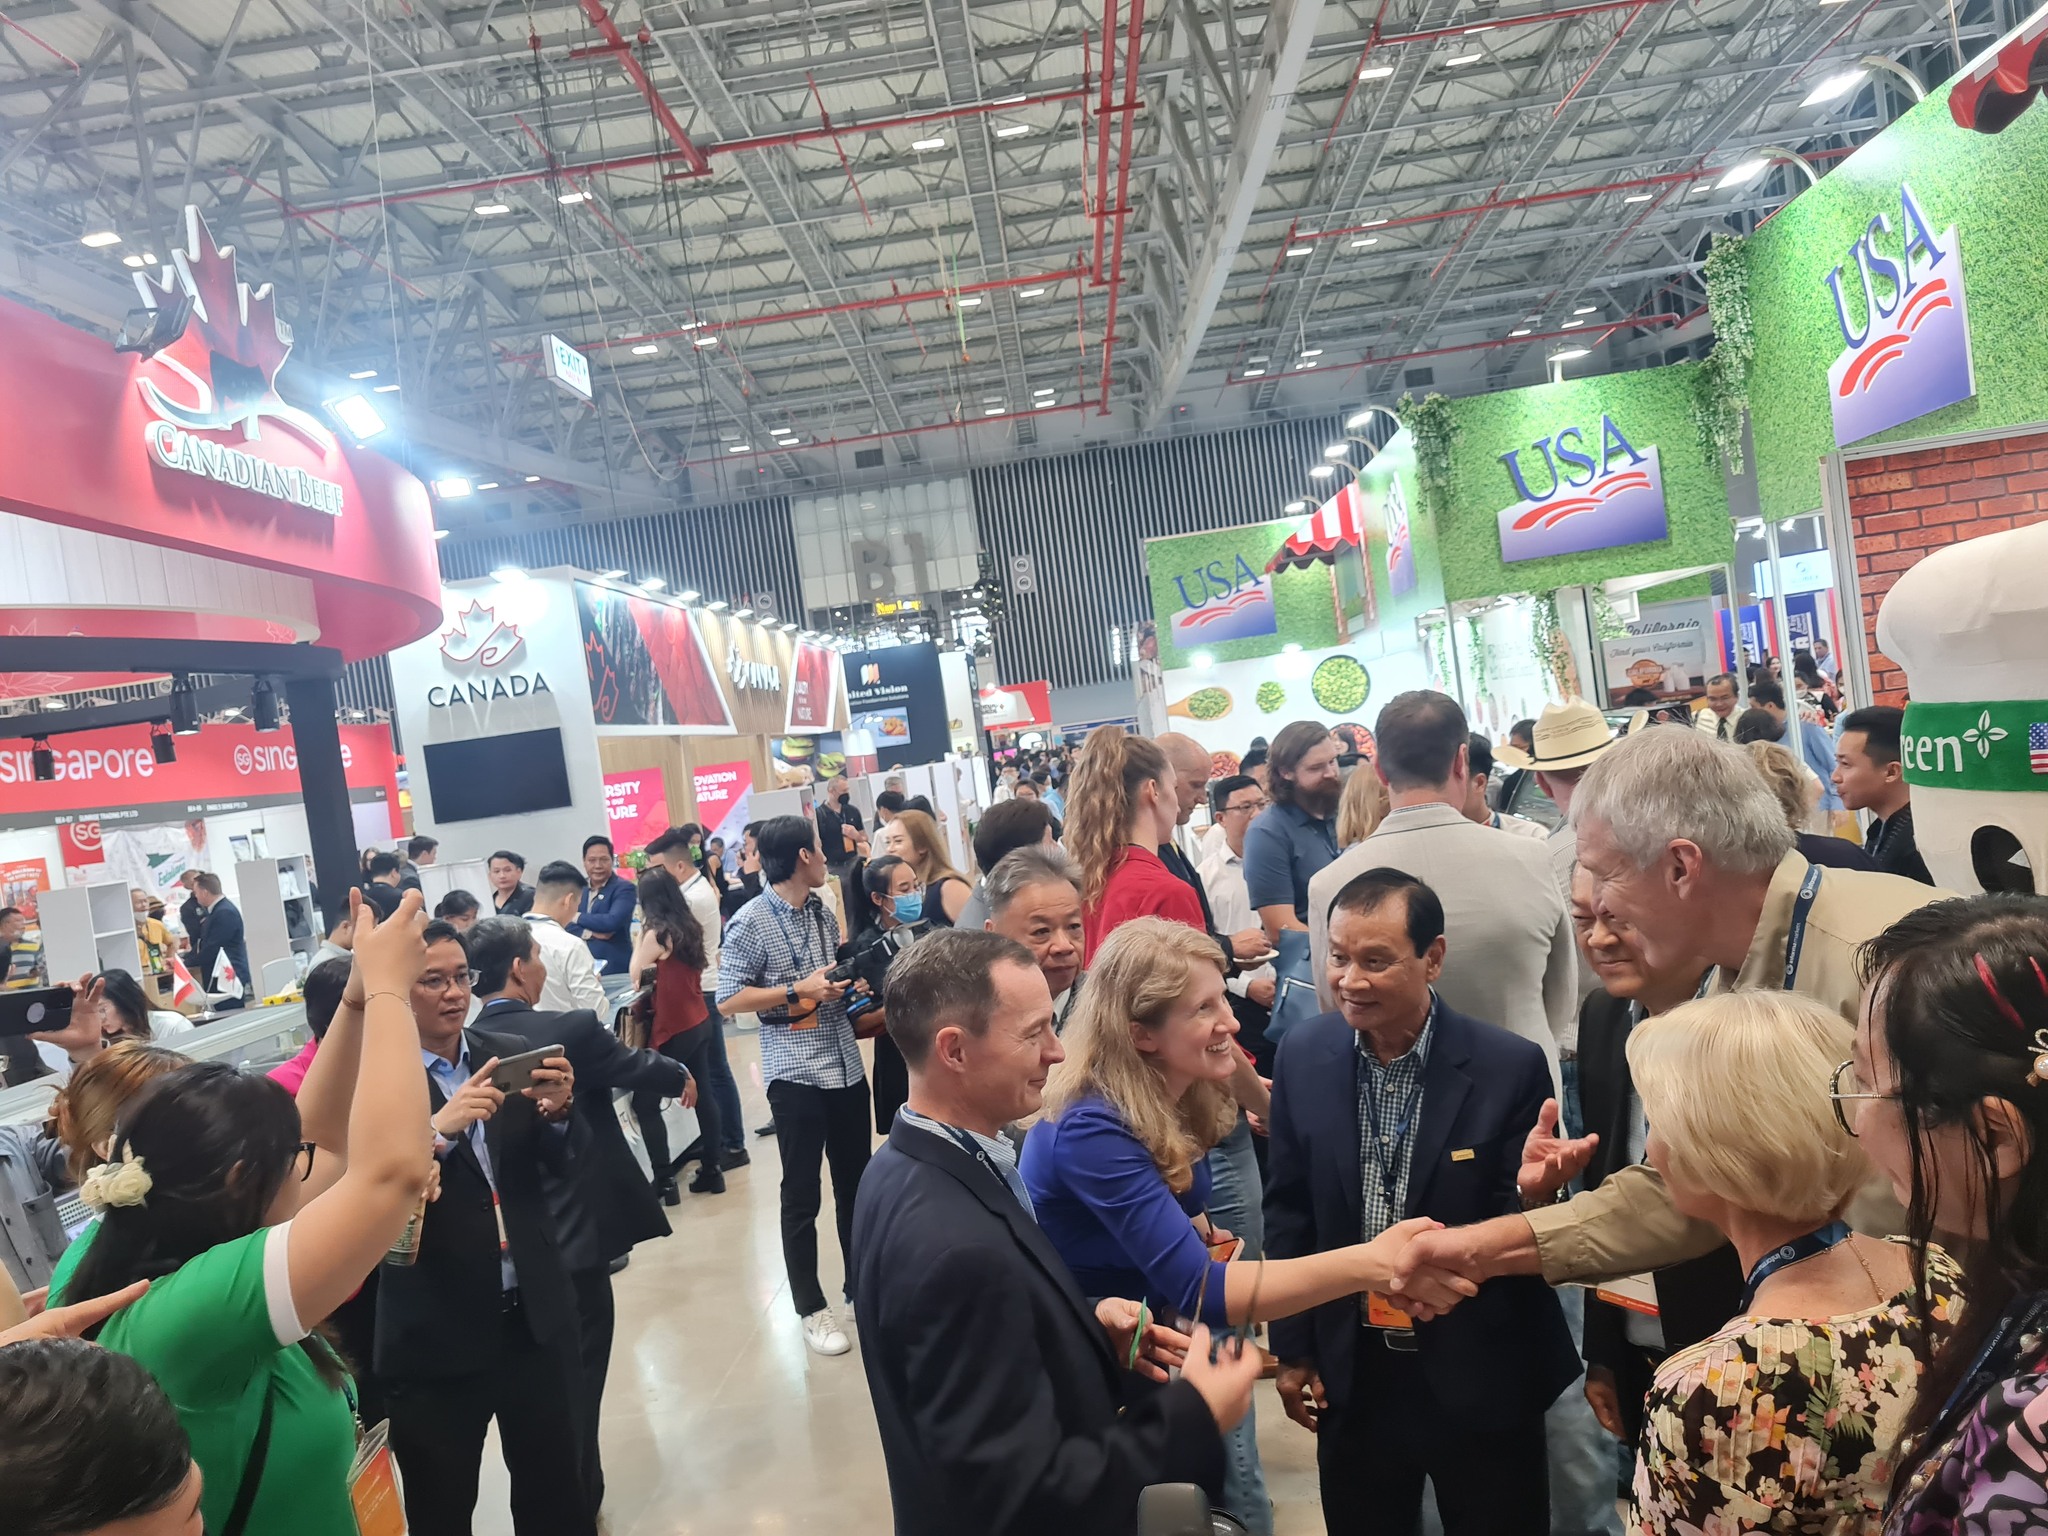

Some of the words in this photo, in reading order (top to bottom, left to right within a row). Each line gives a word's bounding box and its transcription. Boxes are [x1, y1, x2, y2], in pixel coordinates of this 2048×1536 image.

[1825, 182, 1946, 348] USA
[1498, 413, 1648, 503] USA
[851, 532, 931, 602] B1
[1174, 553, 1264, 609] USA
[1653, 641, 1694, 652] California
[428, 672, 551, 708] CANADA
[874, 685, 909, 696] Vision
[75, 822, 101, 841] SG
